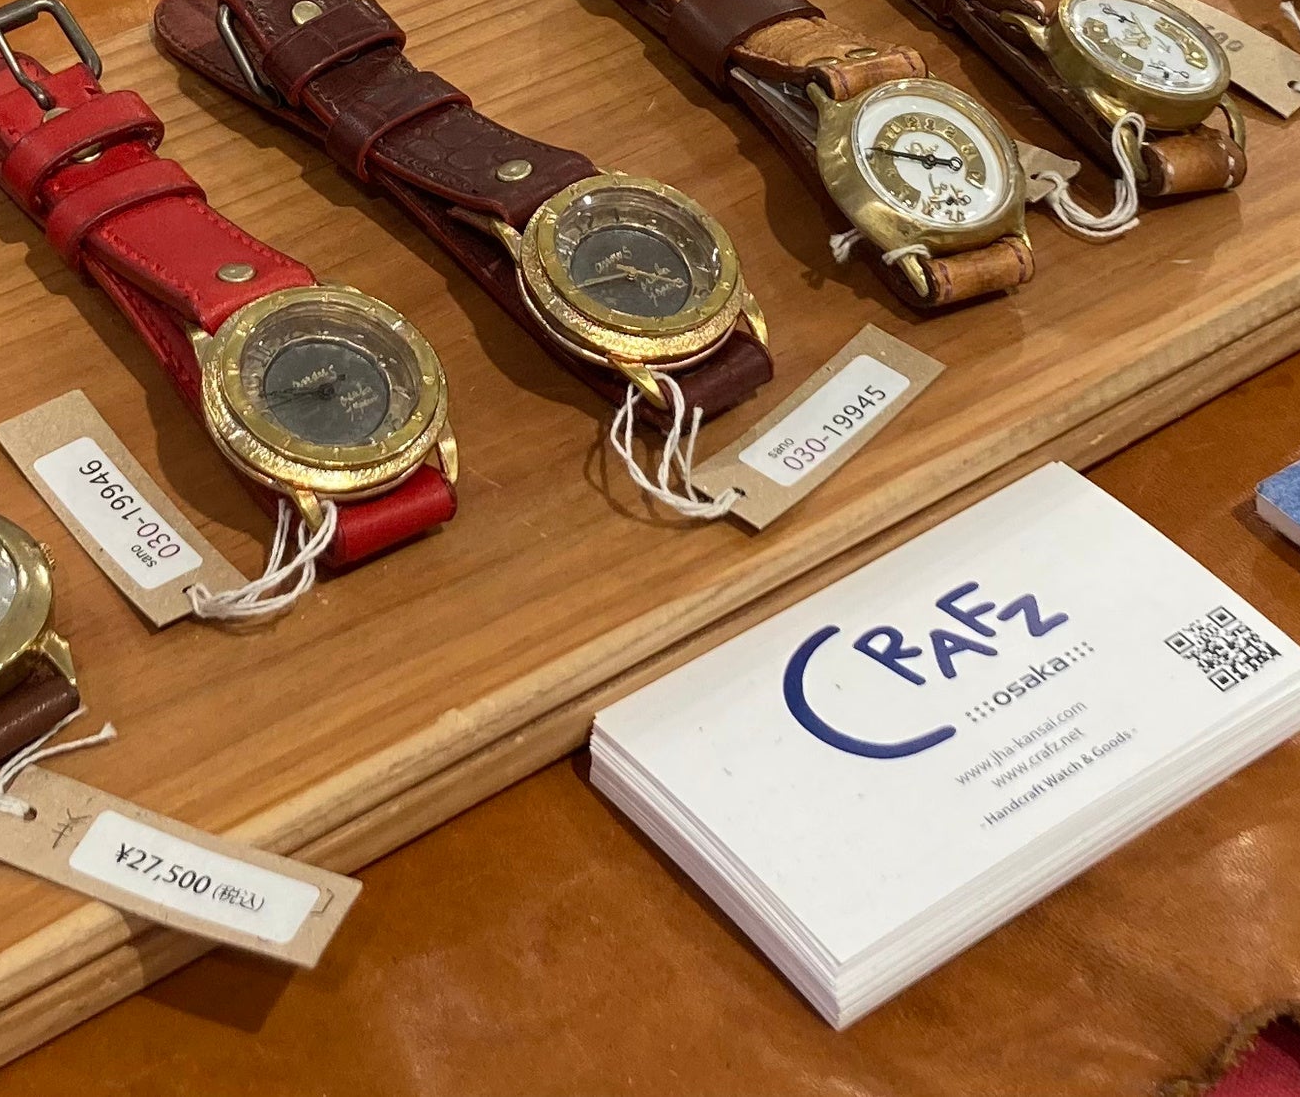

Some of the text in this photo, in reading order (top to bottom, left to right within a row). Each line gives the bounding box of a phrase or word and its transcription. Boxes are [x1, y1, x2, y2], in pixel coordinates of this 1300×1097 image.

[767, 436, 796, 460] sano
[782, 384, 887, 472] 030-19945
[78, 459, 182, 560] 030-19946
[130, 543, 158, 569] sano
[954, 699, 1088, 786] www.jha-kansai.com
[983, 782, 1046, 826] Handcraft
[1043, 759, 1084, 790] Watch
[1090, 730, 1133, 758] Goods
[990, 725, 1086, 788] www.crafz.net
[114, 841, 267, 913] ¥27,500 (税込)
